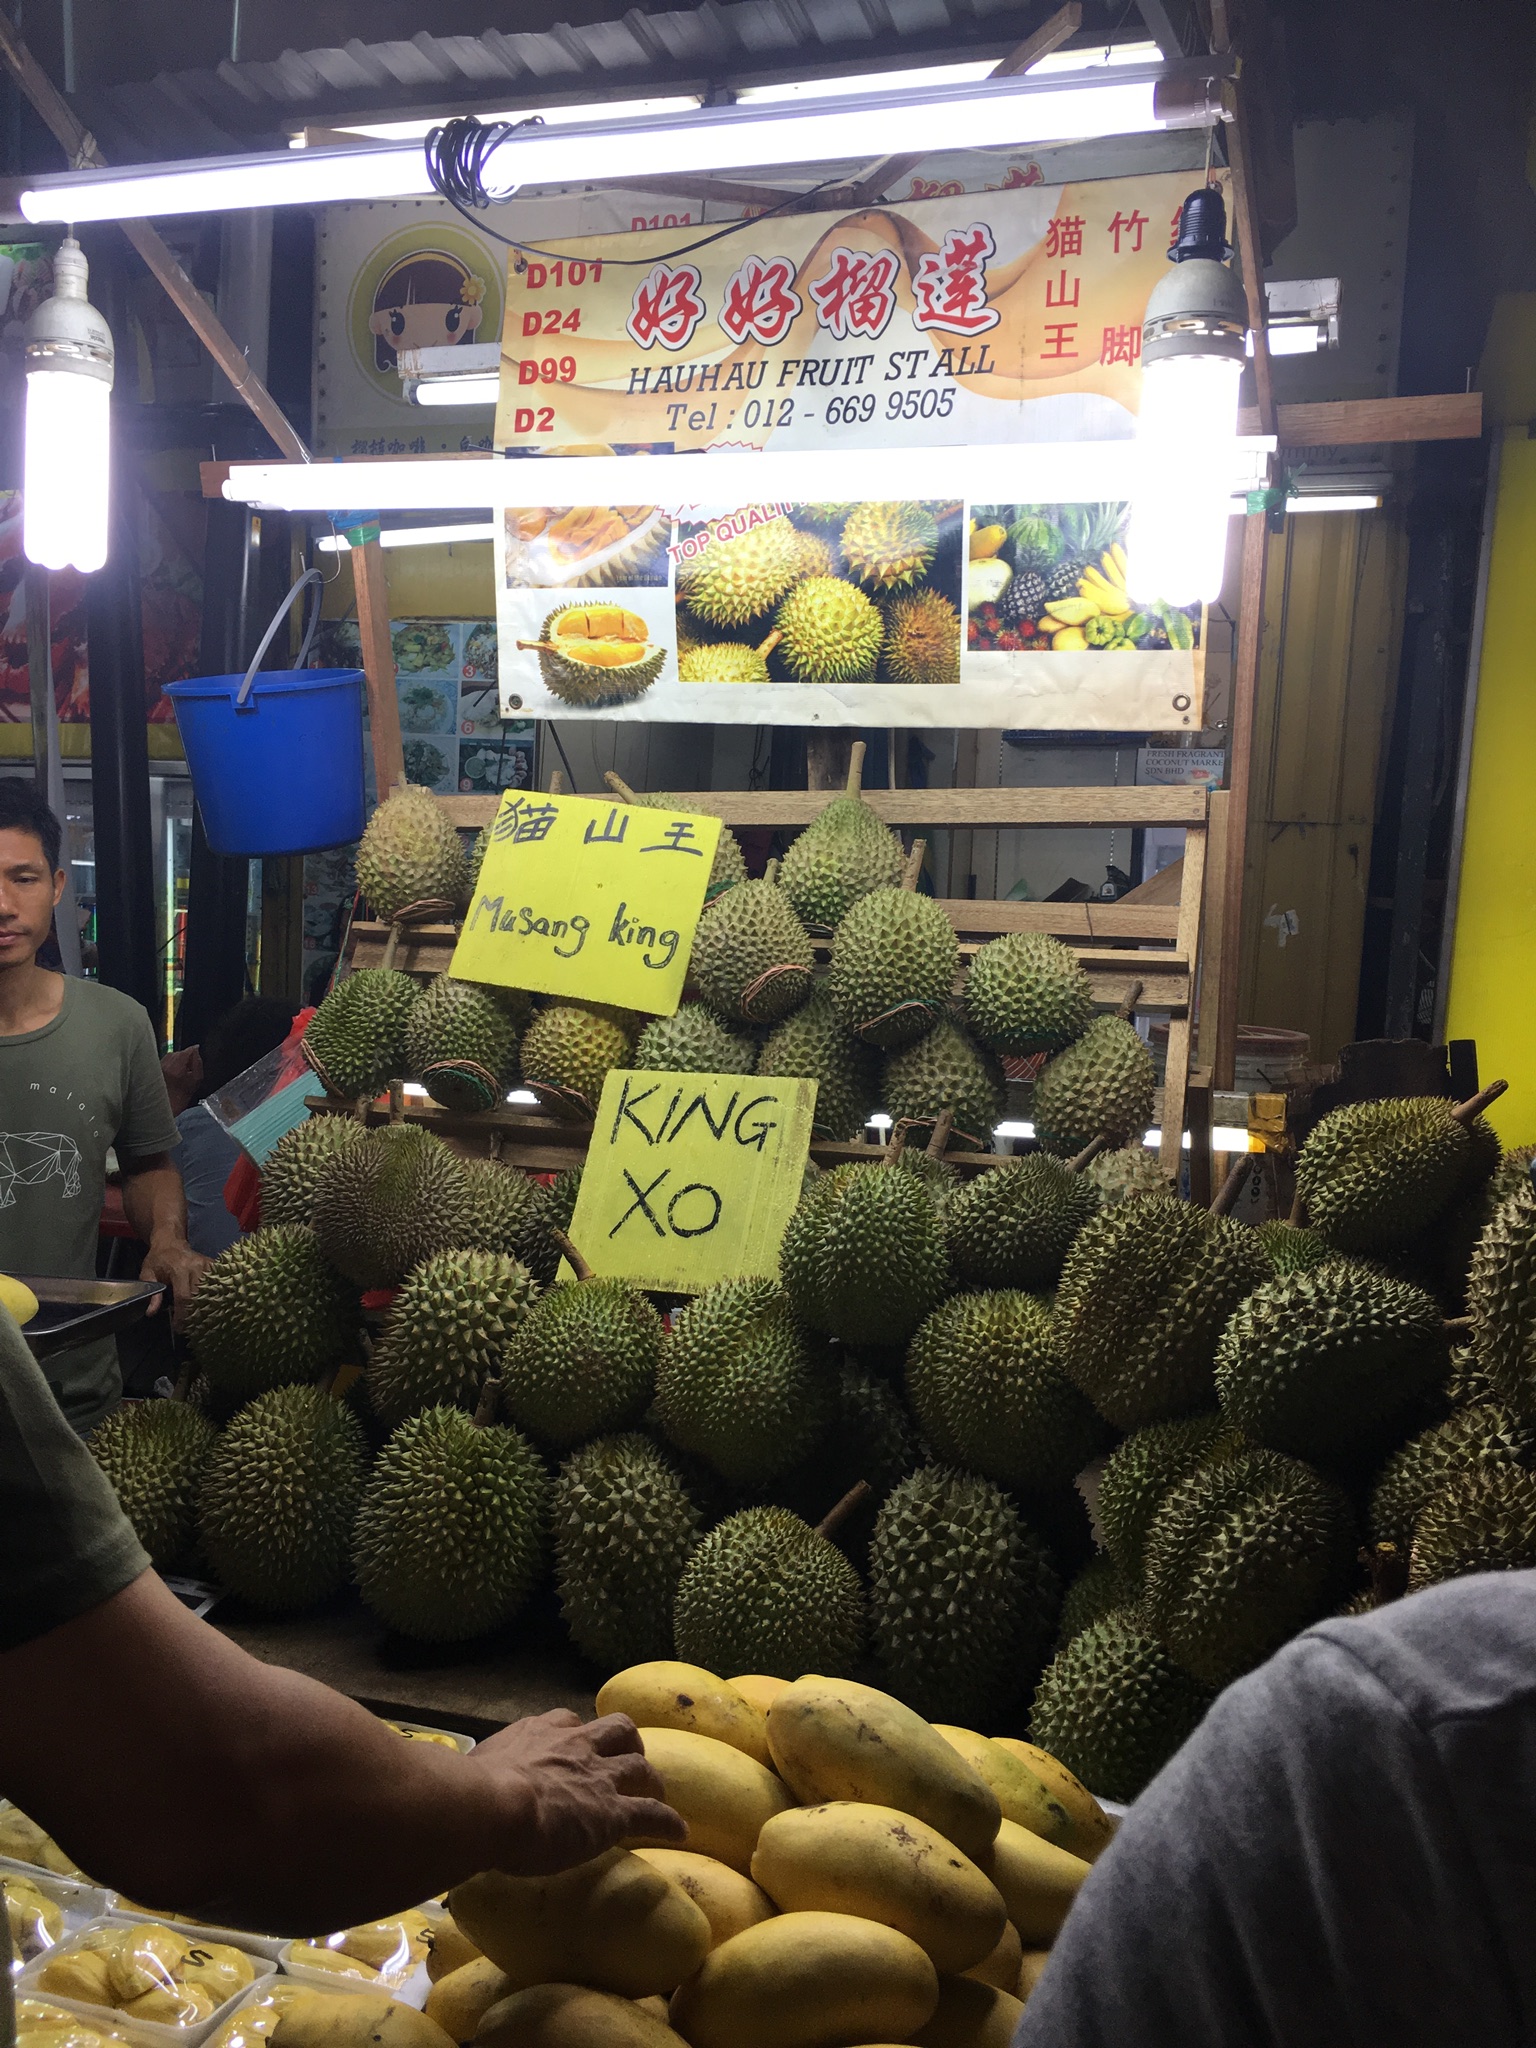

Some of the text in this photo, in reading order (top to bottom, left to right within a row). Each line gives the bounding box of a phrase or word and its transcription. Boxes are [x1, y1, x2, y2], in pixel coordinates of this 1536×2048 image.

[526, 257, 603, 289] D101
[1040, 215, 1087, 360] 猫山王
[521, 307, 582, 337] D24
[517, 355, 577, 386] D99
[626, 344, 996, 395] HAUHAU FRUIT STALL
[514, 406, 556, 433] D2
[824, 393, 877, 425] 669
[884, 387, 957, 421] 9505
[667, 532, 711, 565] TOP
[1147, 750, 1175, 758] FRESH
[1145, 767, 1162, 775] SDN
[1165, 767, 1185, 775] BHD
[469, 895, 680, 969] Musang king
[610, 1076, 778, 1152] KING
[608, 1168, 722, 1239] XO
